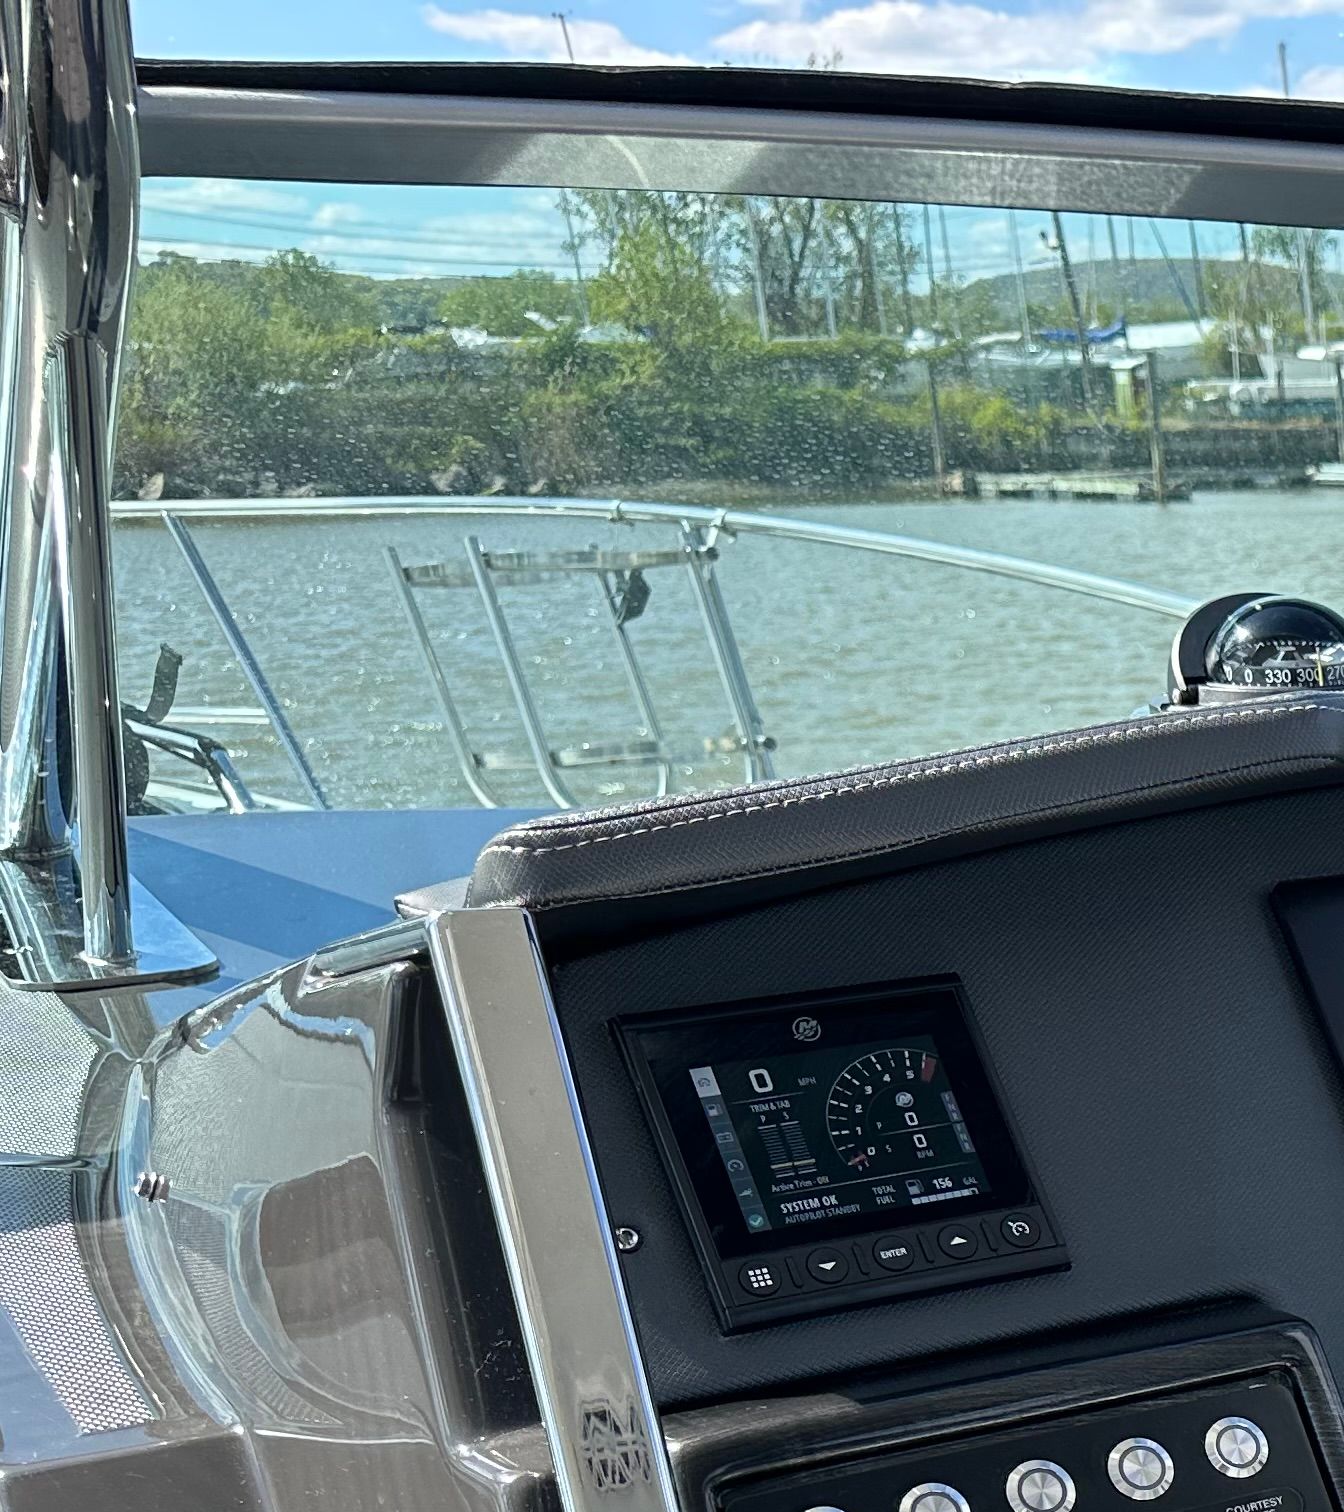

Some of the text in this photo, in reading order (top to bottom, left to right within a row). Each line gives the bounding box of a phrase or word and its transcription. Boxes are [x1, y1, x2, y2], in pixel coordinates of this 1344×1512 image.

[1265, 669, 1292, 684] 330
[748, 1068, 774, 1094] 0
[883, 1073, 892, 1083] 4
[905, 1070, 915, 1080] 5
[864, 1085, 873, 1095] 3
[854, 1104, 864, 1114] 2
[904, 1112, 919, 1126] 0
[913, 1134, 928, 1148] 0
[867, 1146, 876, 1156] 0
[932, 1177, 953, 1190] 156
[872, 1184, 896, 1196] TOTAL
[780, 1194, 840, 1215] SYSTEM OK
[880, 1247, 908, 1259] ENTER
